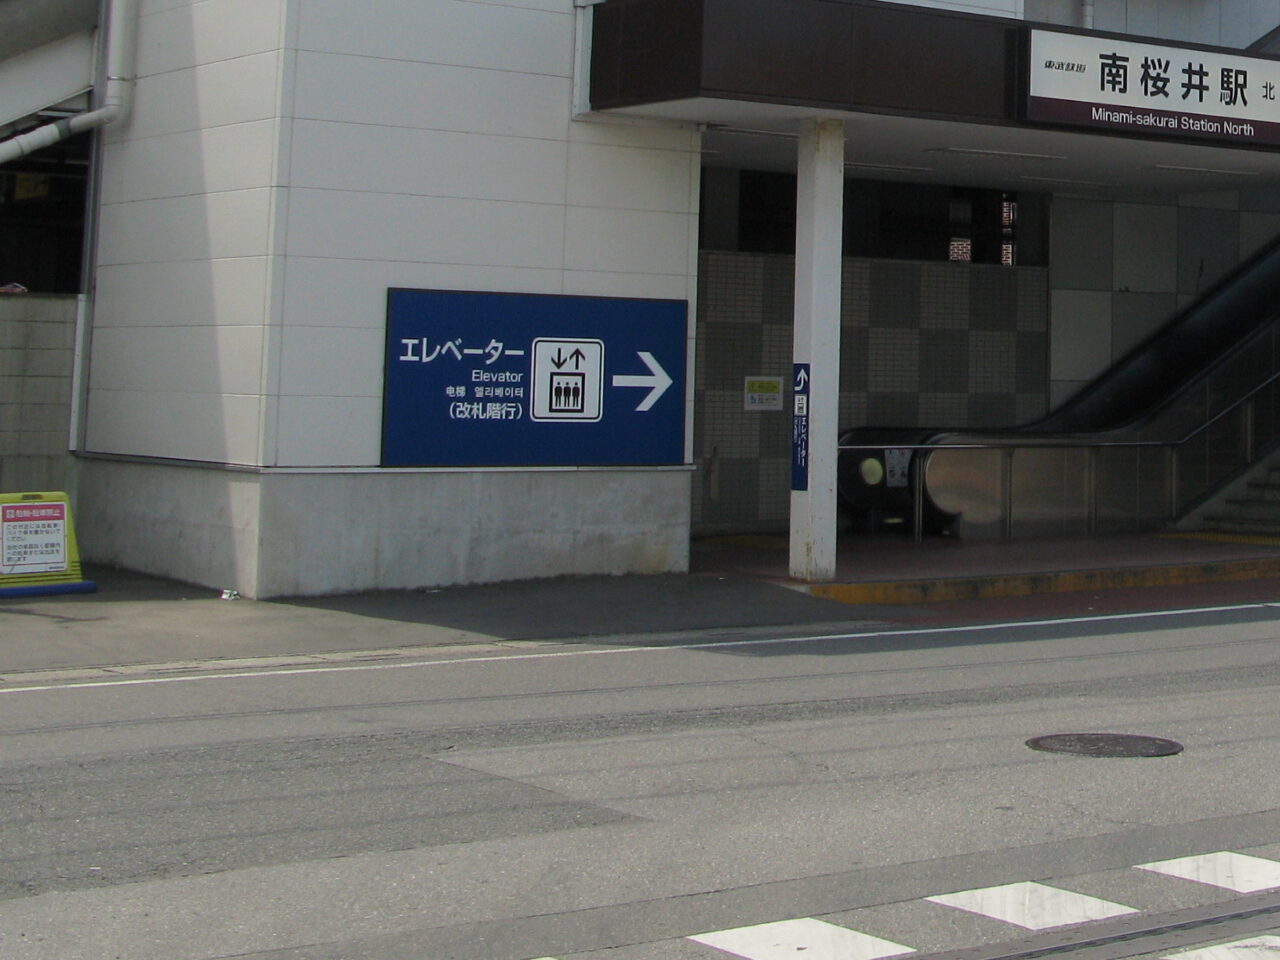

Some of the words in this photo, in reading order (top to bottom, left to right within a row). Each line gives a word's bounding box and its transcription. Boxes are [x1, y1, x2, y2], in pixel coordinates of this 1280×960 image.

[1098, 52, 1249, 108] 南桜井駅
[1091, 107, 1178, 129] Minami-sakurai
[1181, 116, 1221, 133] Station
[1224, 121, 1255, 137] North
[399, 338, 524, 365] エレベーター
[471, 369, 523, 382] Elevator
[474, 386, 523, 398] 엘리베이터
